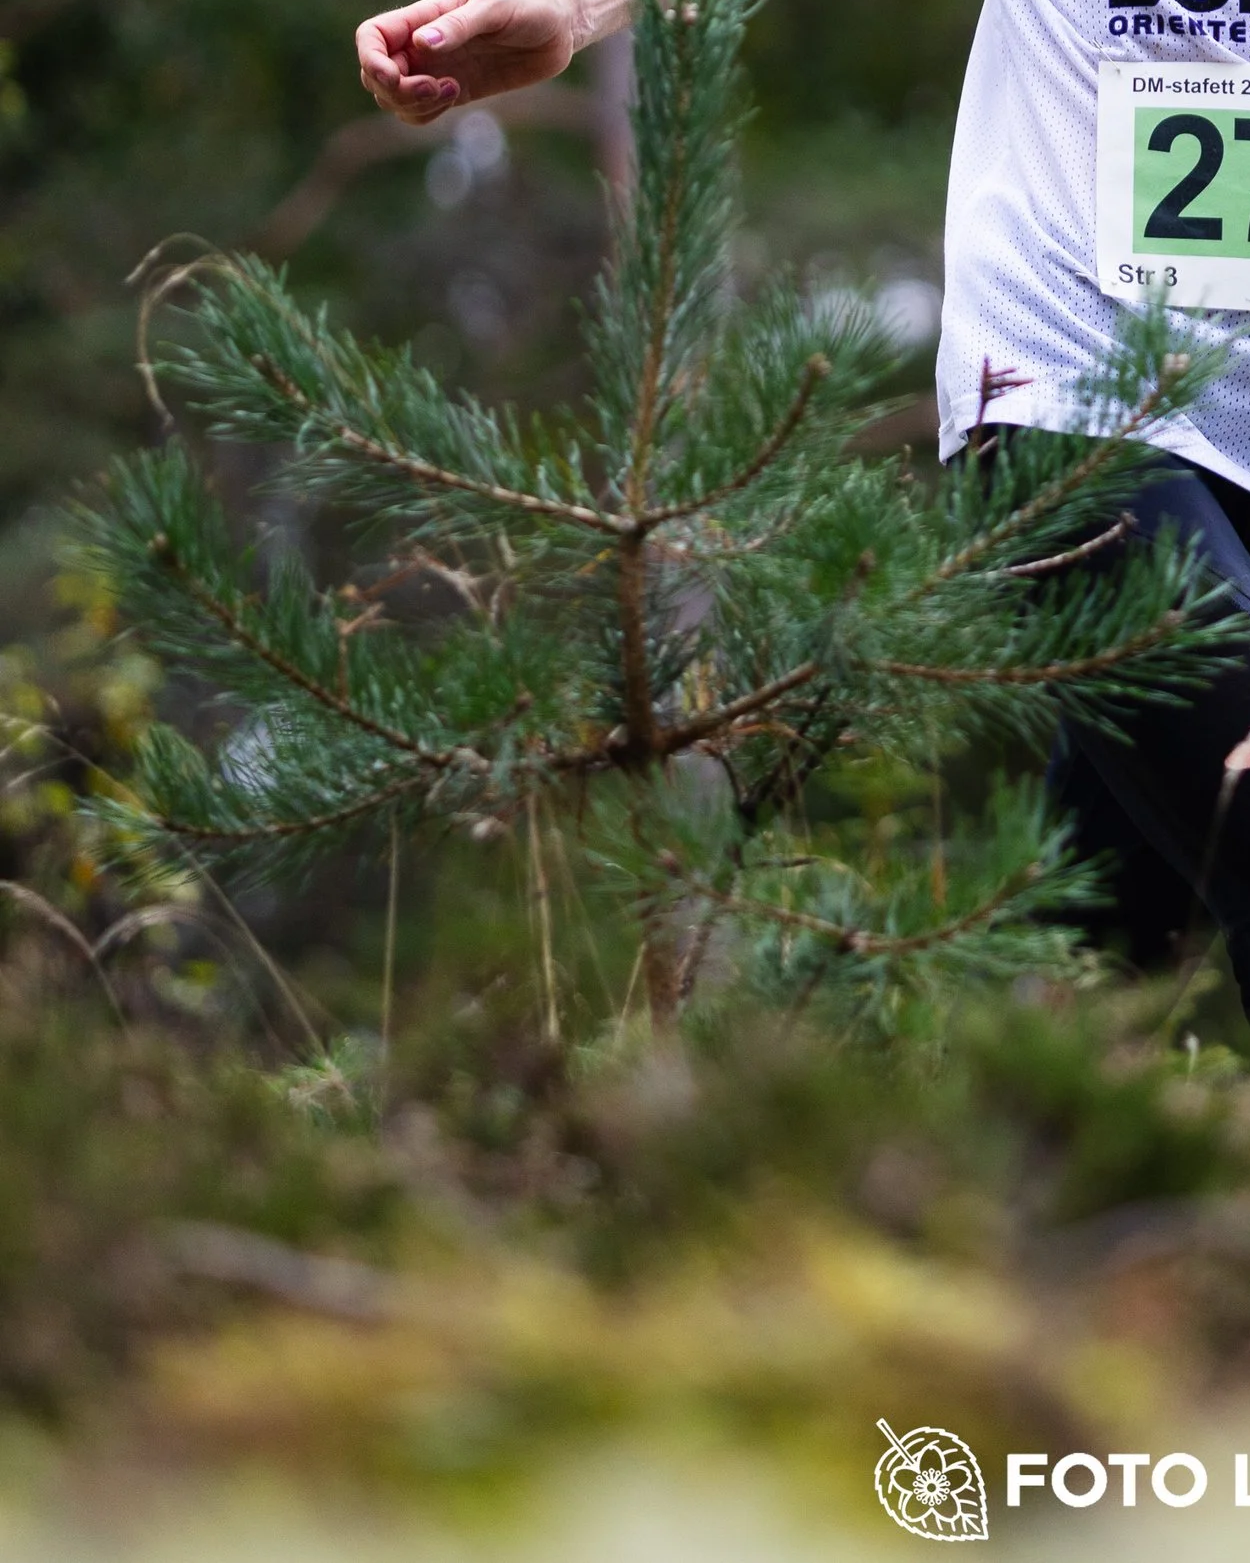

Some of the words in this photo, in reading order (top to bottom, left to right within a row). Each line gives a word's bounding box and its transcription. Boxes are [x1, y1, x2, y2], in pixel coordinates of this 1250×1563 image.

[1132, 77, 1235, 95] DM-stafett
[1118, 263, 1155, 285] Str
[1164, 266, 1178, 286] 3
